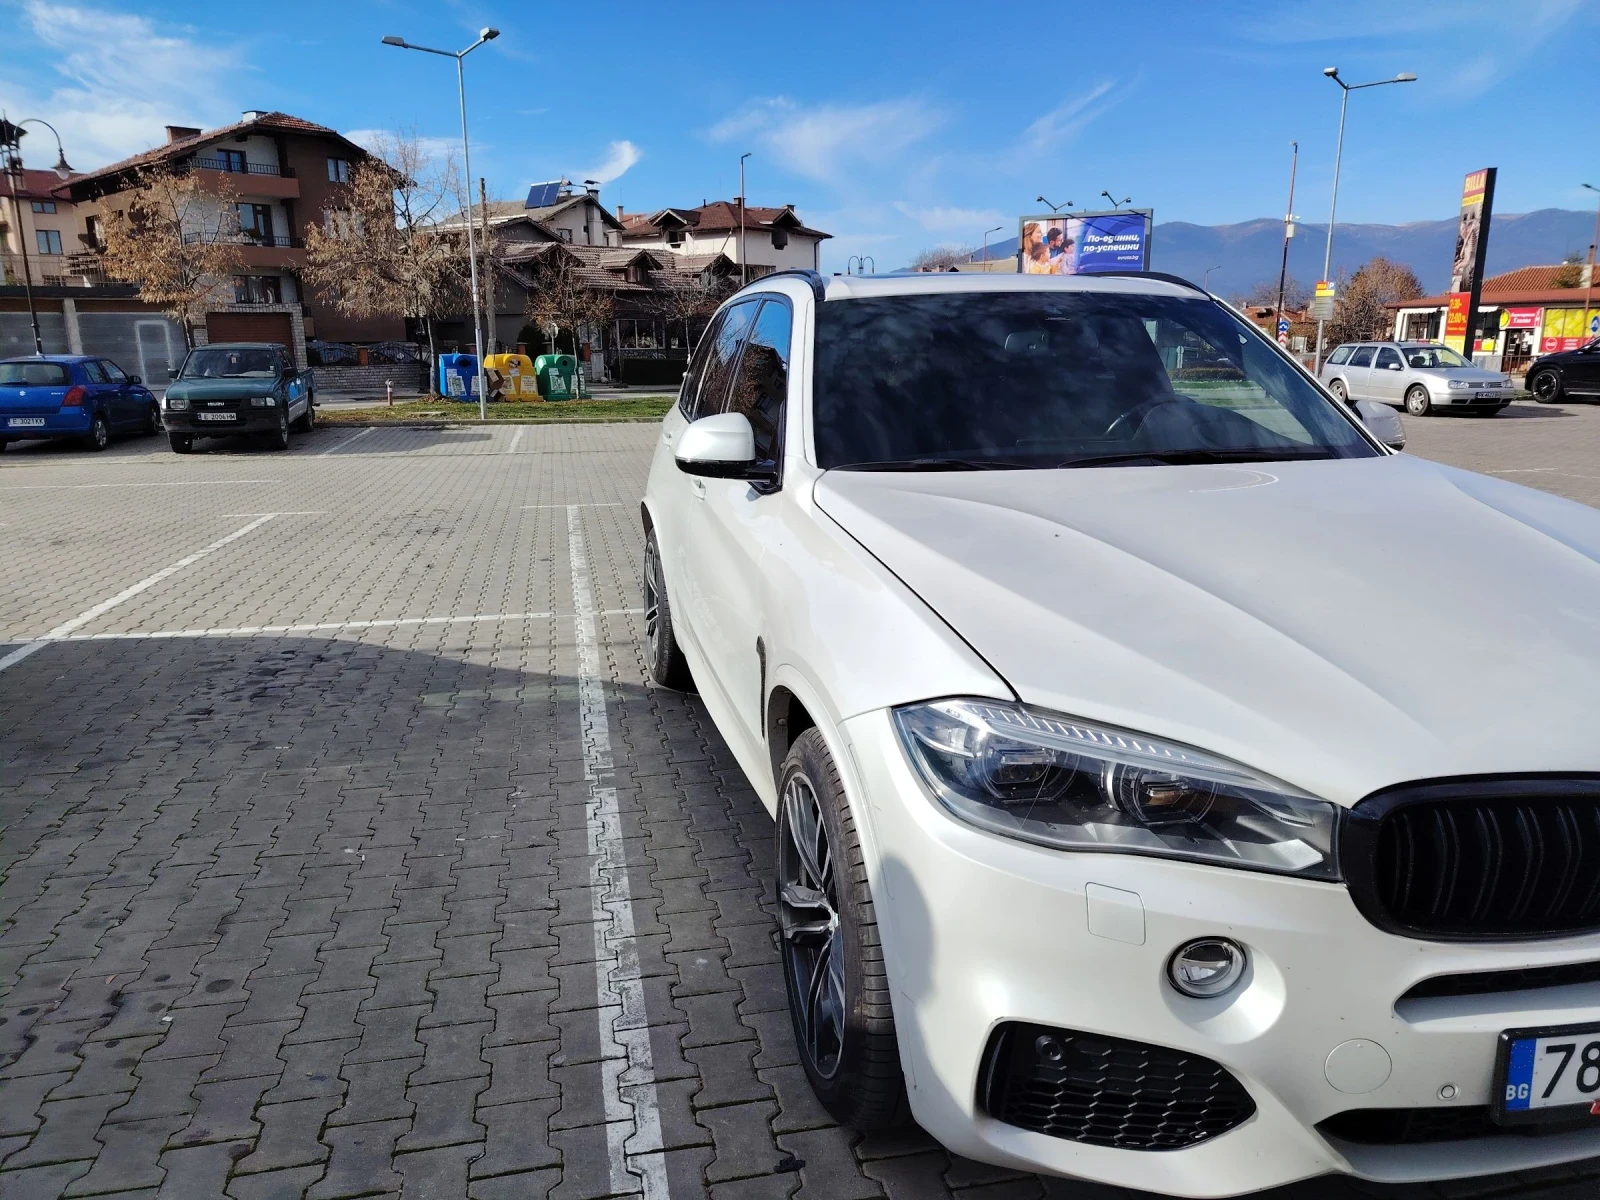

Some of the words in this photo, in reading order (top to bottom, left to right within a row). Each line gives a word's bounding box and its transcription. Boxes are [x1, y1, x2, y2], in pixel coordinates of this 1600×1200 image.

[1464, 173, 1485, 193] BILLA
[1083, 243, 1140, 253] по-успешни
[1448, 313, 1462, 324] 22:00
[1506, 1083, 1528, 1100] BG
